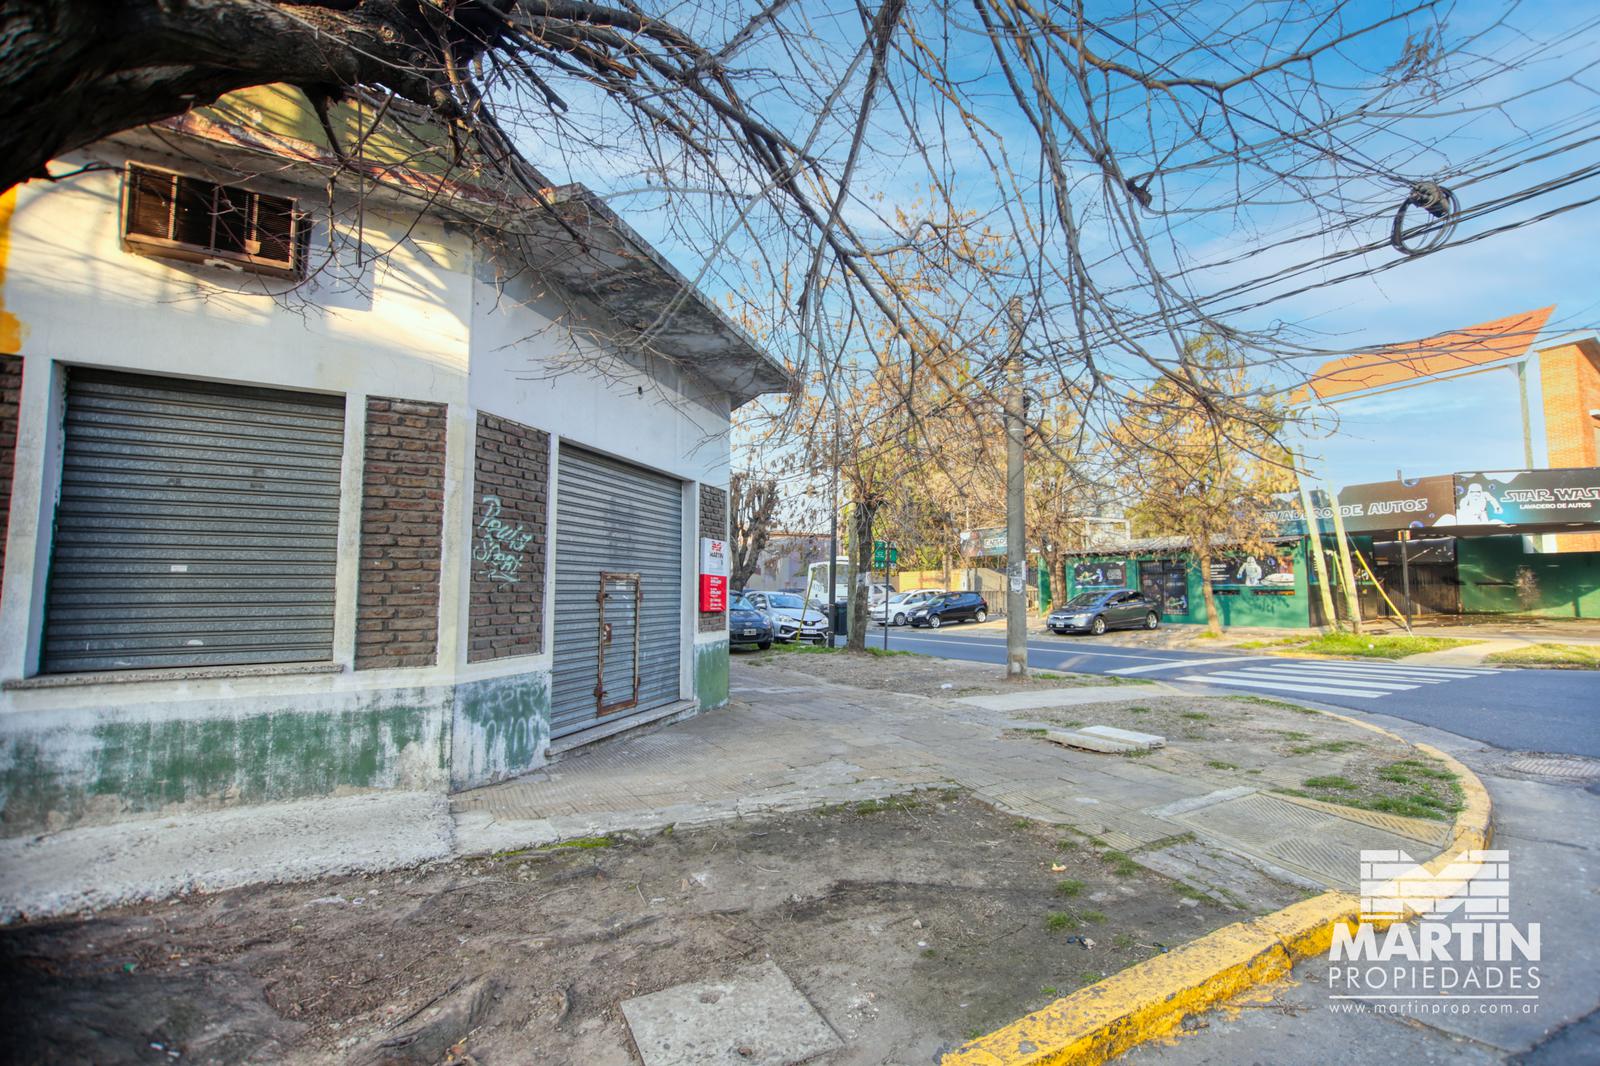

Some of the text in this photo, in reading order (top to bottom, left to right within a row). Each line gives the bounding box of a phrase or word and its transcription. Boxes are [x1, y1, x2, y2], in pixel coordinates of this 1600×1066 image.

[1500, 488, 1555, 502] STAR
[1340, 504, 1364, 516] DE
[1367, 498, 1428, 515] AUTOS
